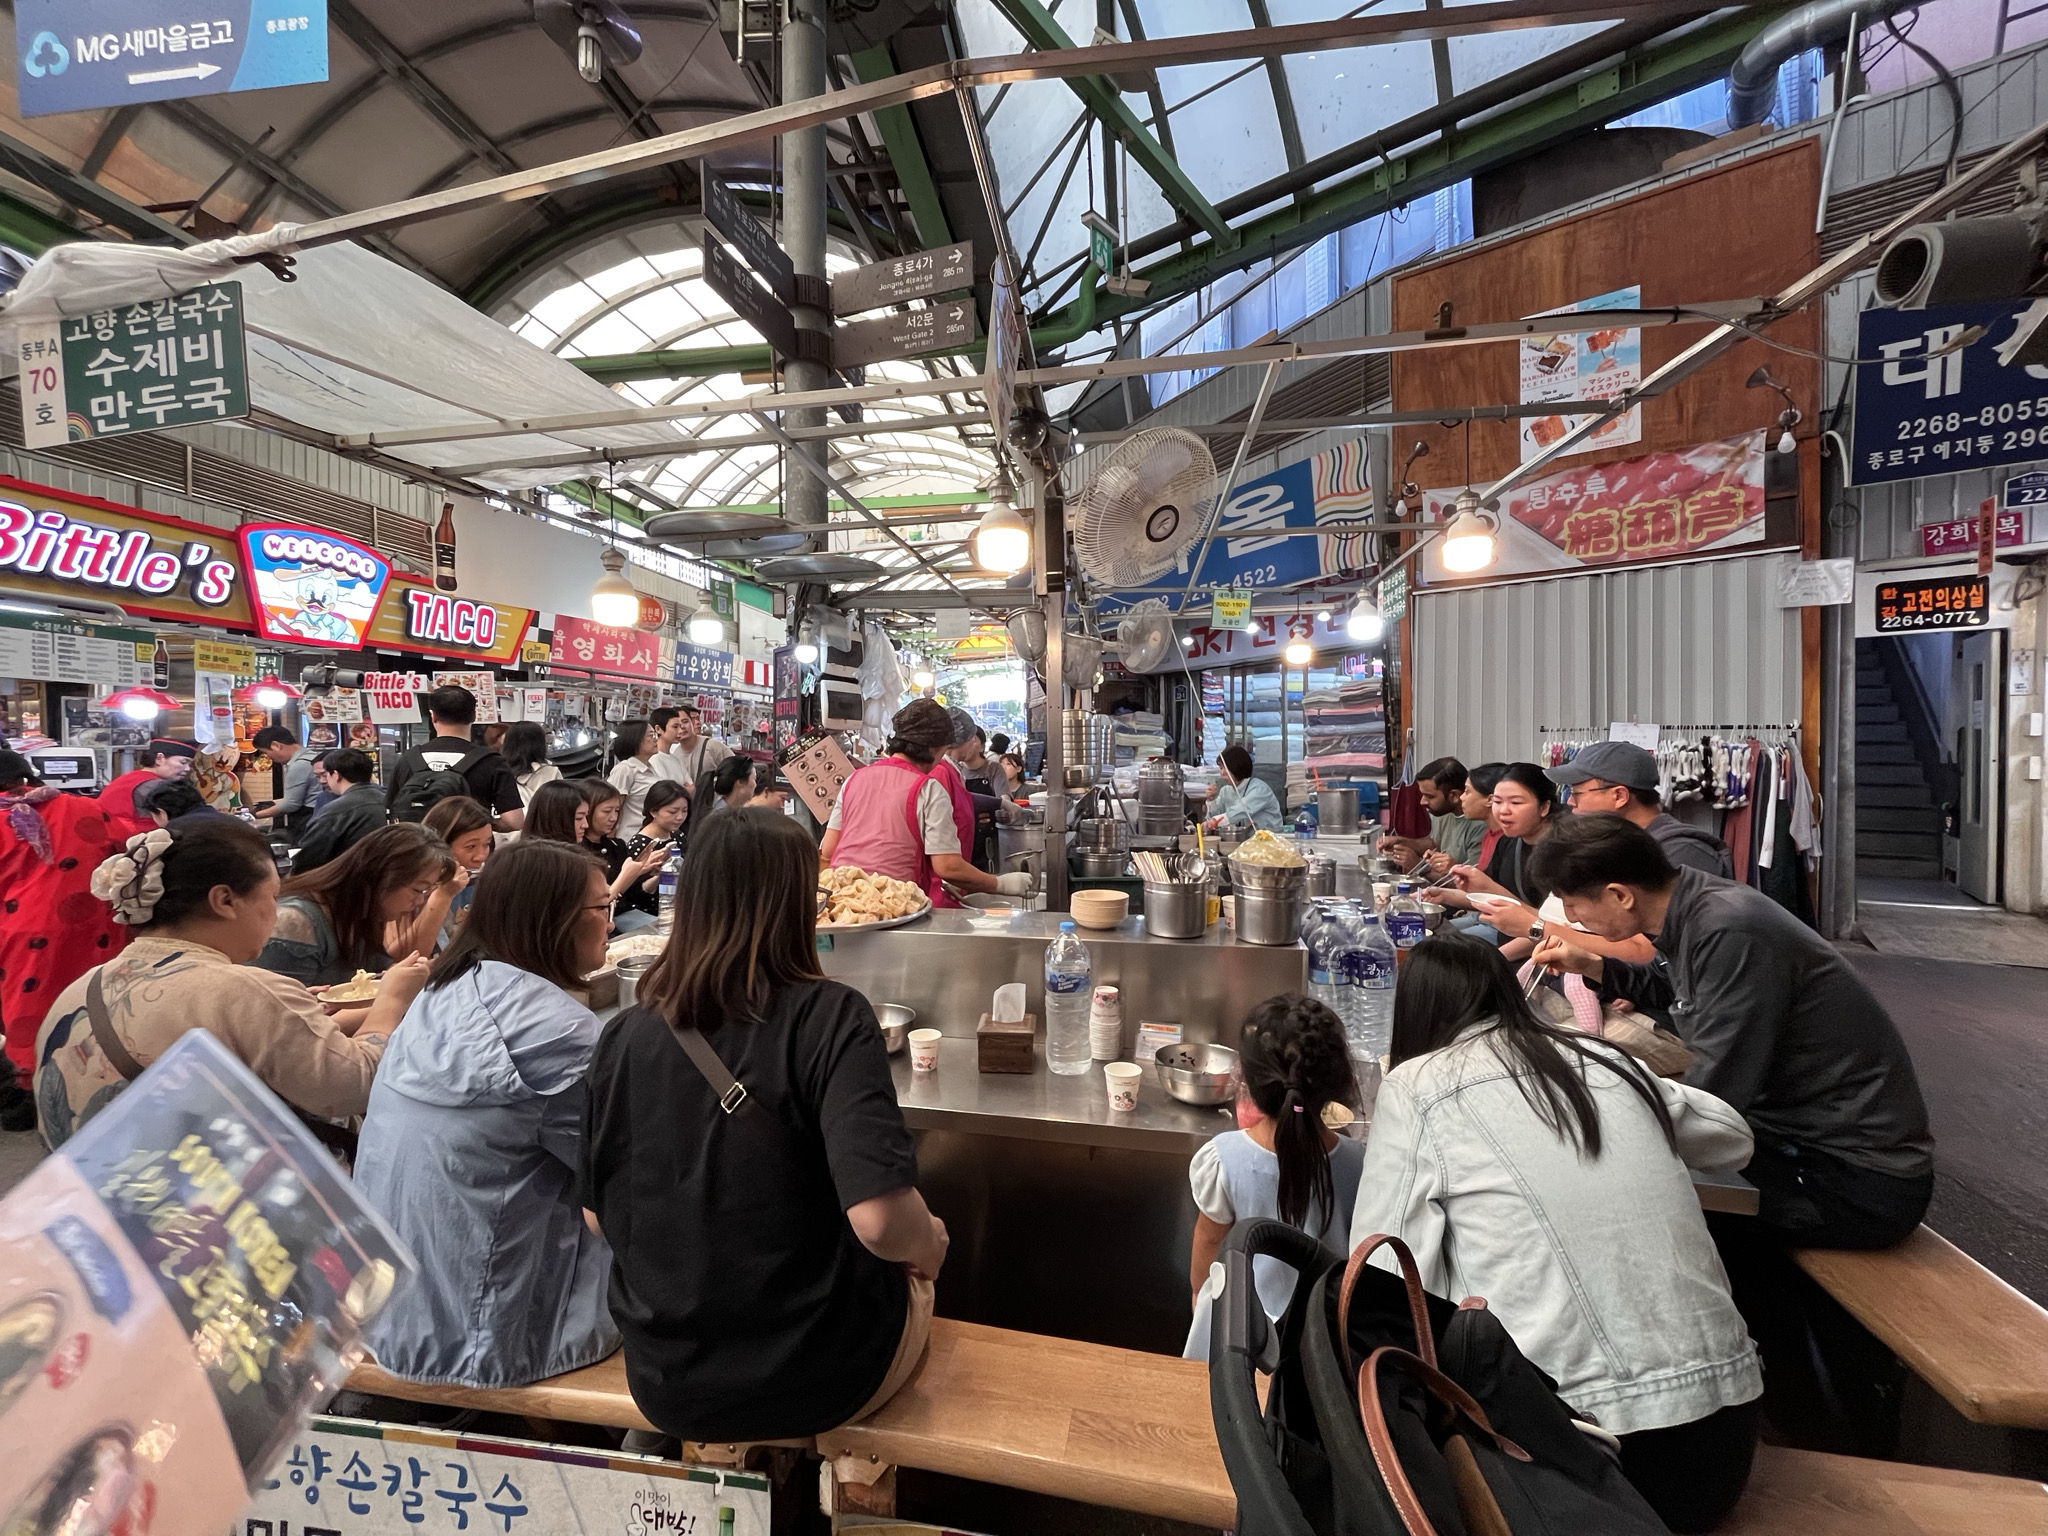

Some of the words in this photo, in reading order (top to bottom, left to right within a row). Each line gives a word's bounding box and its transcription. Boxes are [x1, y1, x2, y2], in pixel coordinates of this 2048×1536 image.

[893, 256, 934, 277] 종로4가
[943, 268, 955, 278] 285
[956, 266, 964, 275] m
[66, 311, 118, 342] 고향
[124, 288, 234, 336] 손칼국수
[905, 312, 935, 329] 서2문
[892, 334, 911, 344] West
[911, 331, 928, 341] Gate
[85, 329, 225, 388] 수제비
[28, 365, 58, 395] 70
[1581, 376, 1640, 396] アイスクリーム
[1588, 370, 1631, 386] マシュマロ
[35, 402, 57, 427] 호
[90, 376, 232, 433] 만두국
[1867, 445, 1926, 471] 종로구
[1932, 433, 1995, 460] 예지동
[1527, 472, 1609, 511] 탕후루
[1926, 515, 2021, 547] 강희복
[0, 500, 236, 605] Bittle's
[265, 536, 373, 576] WELCOME
[1218, 592, 1248, 600] 새마을금고
[1902, 583, 1985, 613] 고전의상실
[407, 588, 498, 648] TACO
[1881, 610, 1977, 629] 2264-0777
[572, 637, 653, 672] 영화사
[688, 655, 732, 684] 우양상회
[364, 672, 422, 691] Bittle's
[373, 691, 413, 710] TACO
[775, 700, 798, 717] NETFLIX
[264, 1443, 529, 1533] 향손칼국수
[642, 1506, 697, 1536] 대박!
